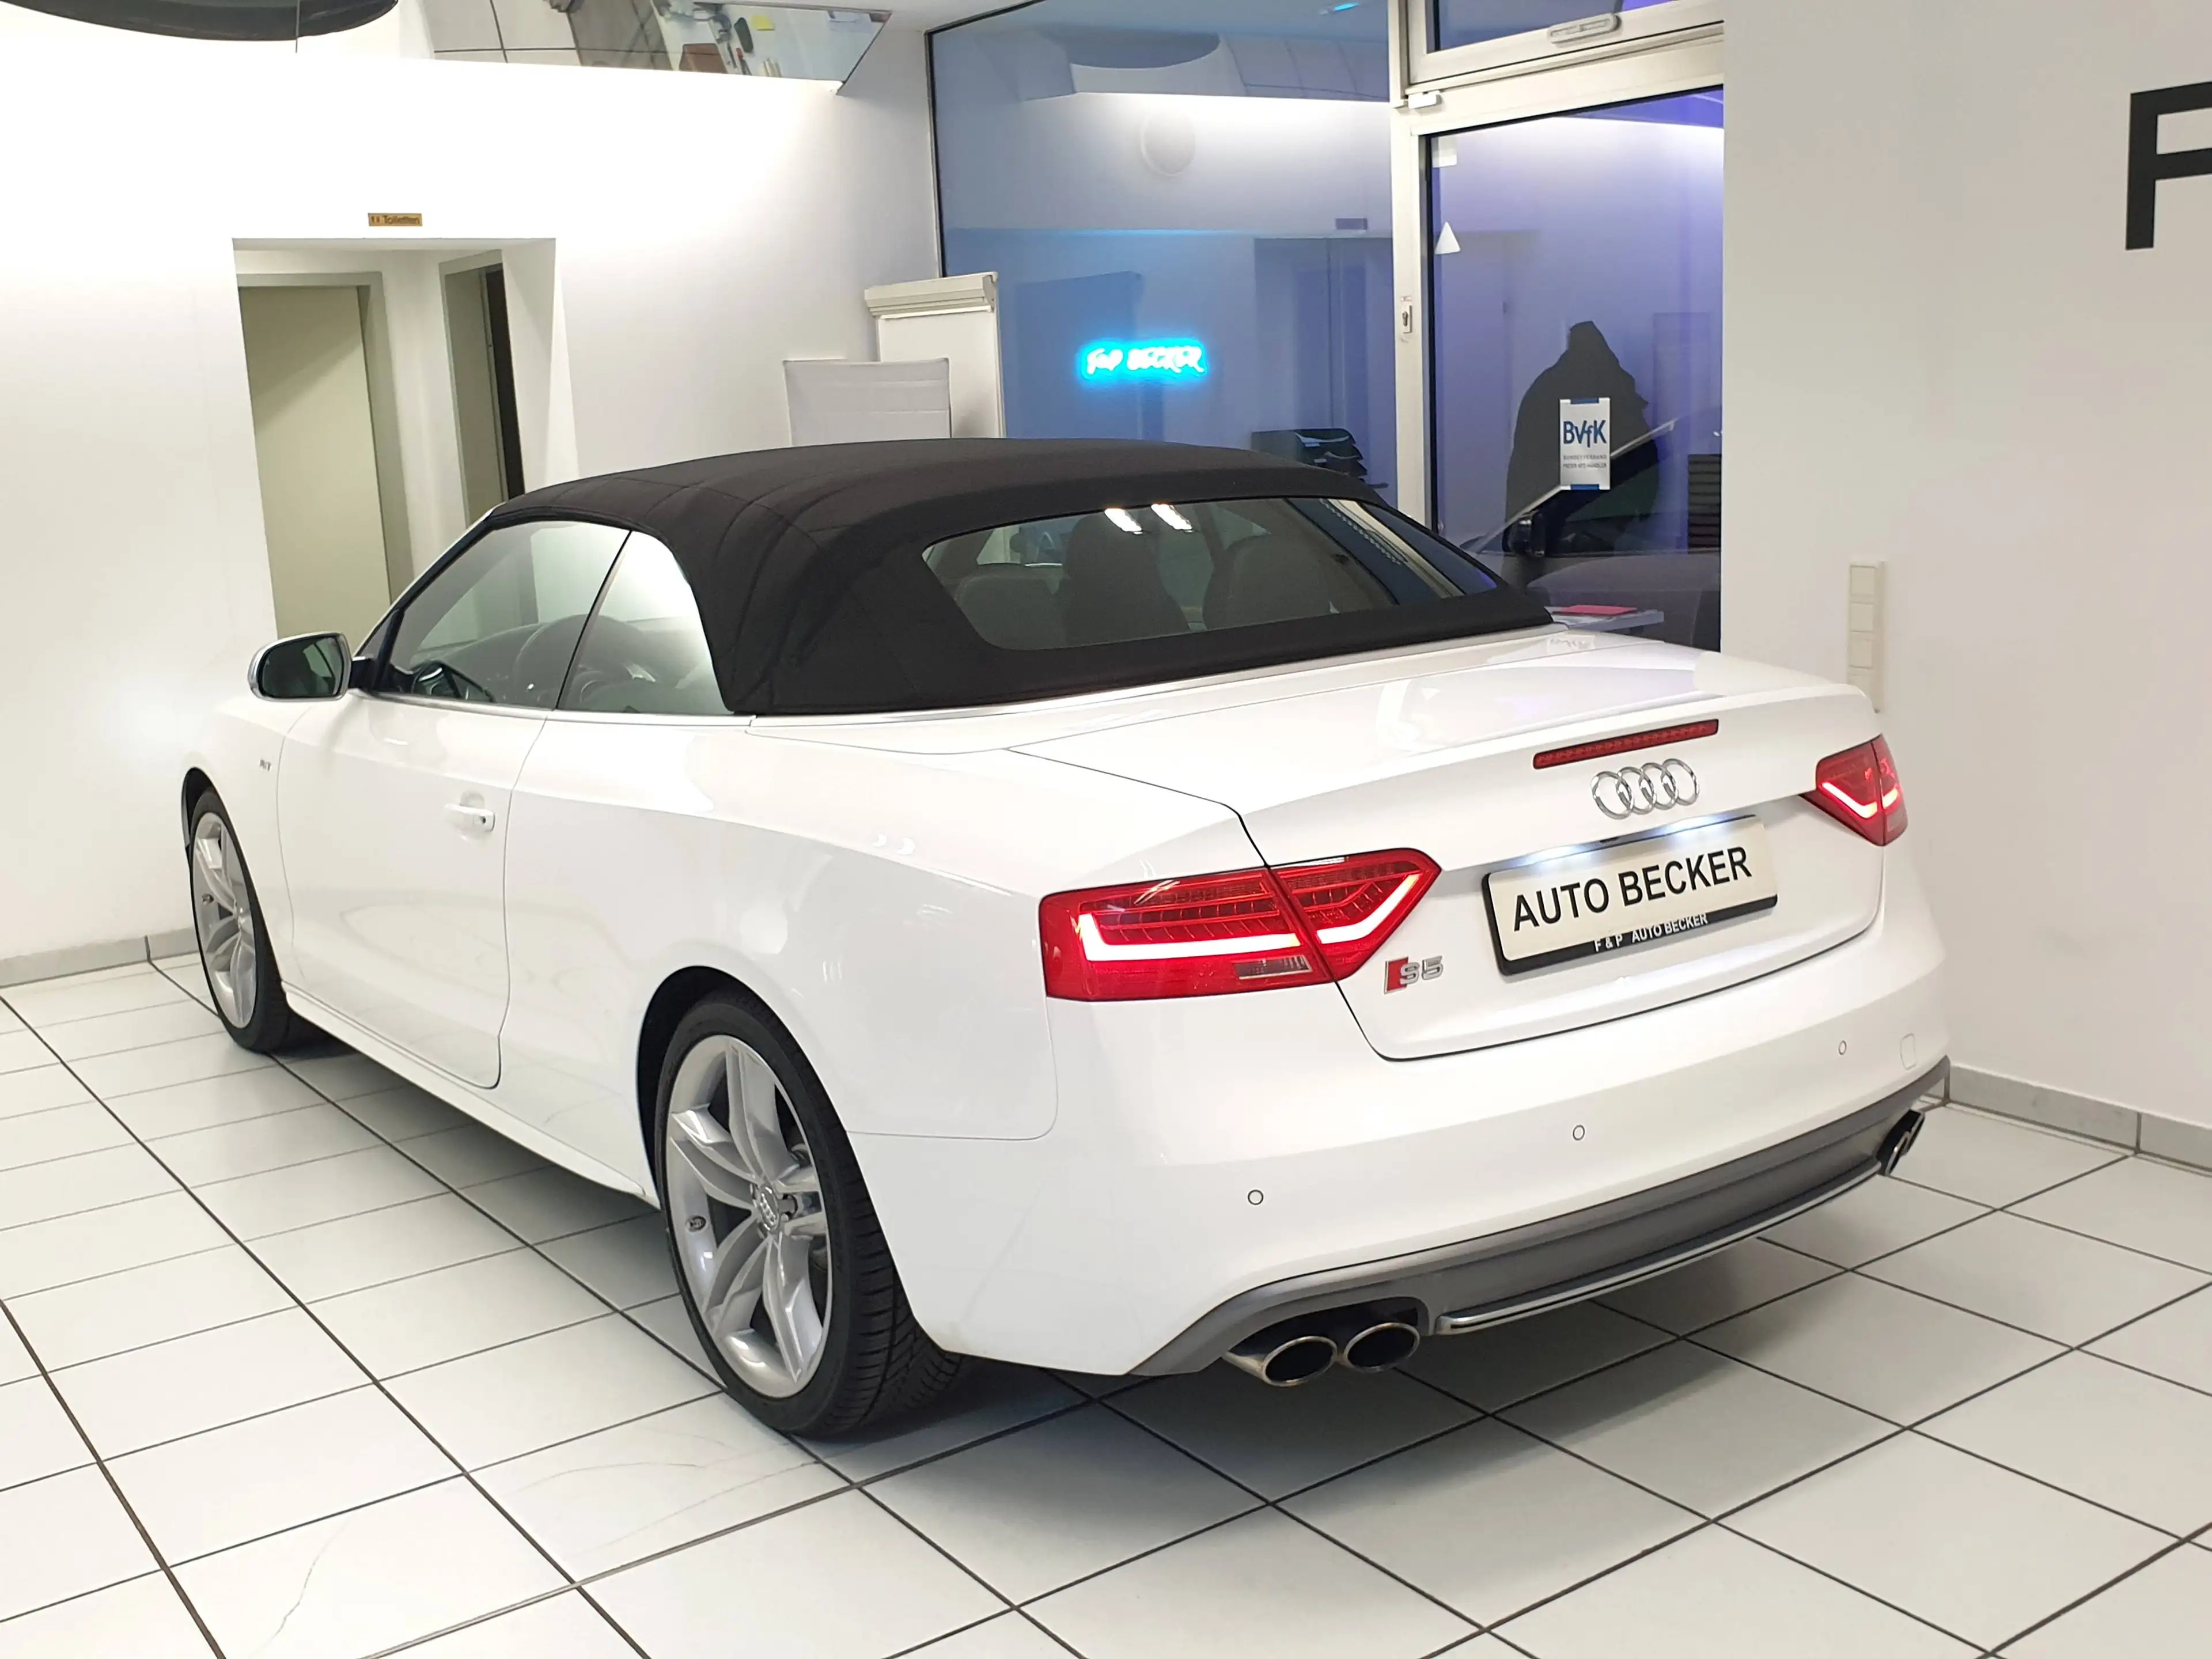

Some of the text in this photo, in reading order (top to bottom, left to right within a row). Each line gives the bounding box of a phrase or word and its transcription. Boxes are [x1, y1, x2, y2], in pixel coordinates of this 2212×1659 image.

[1563, 419, 1607, 448] BVfK
[1513, 846, 1752, 931] AUTO BECKER
[1593, 912, 1709, 952] F & P AUTO BECKER
[1399, 955, 1444, 984] S5
